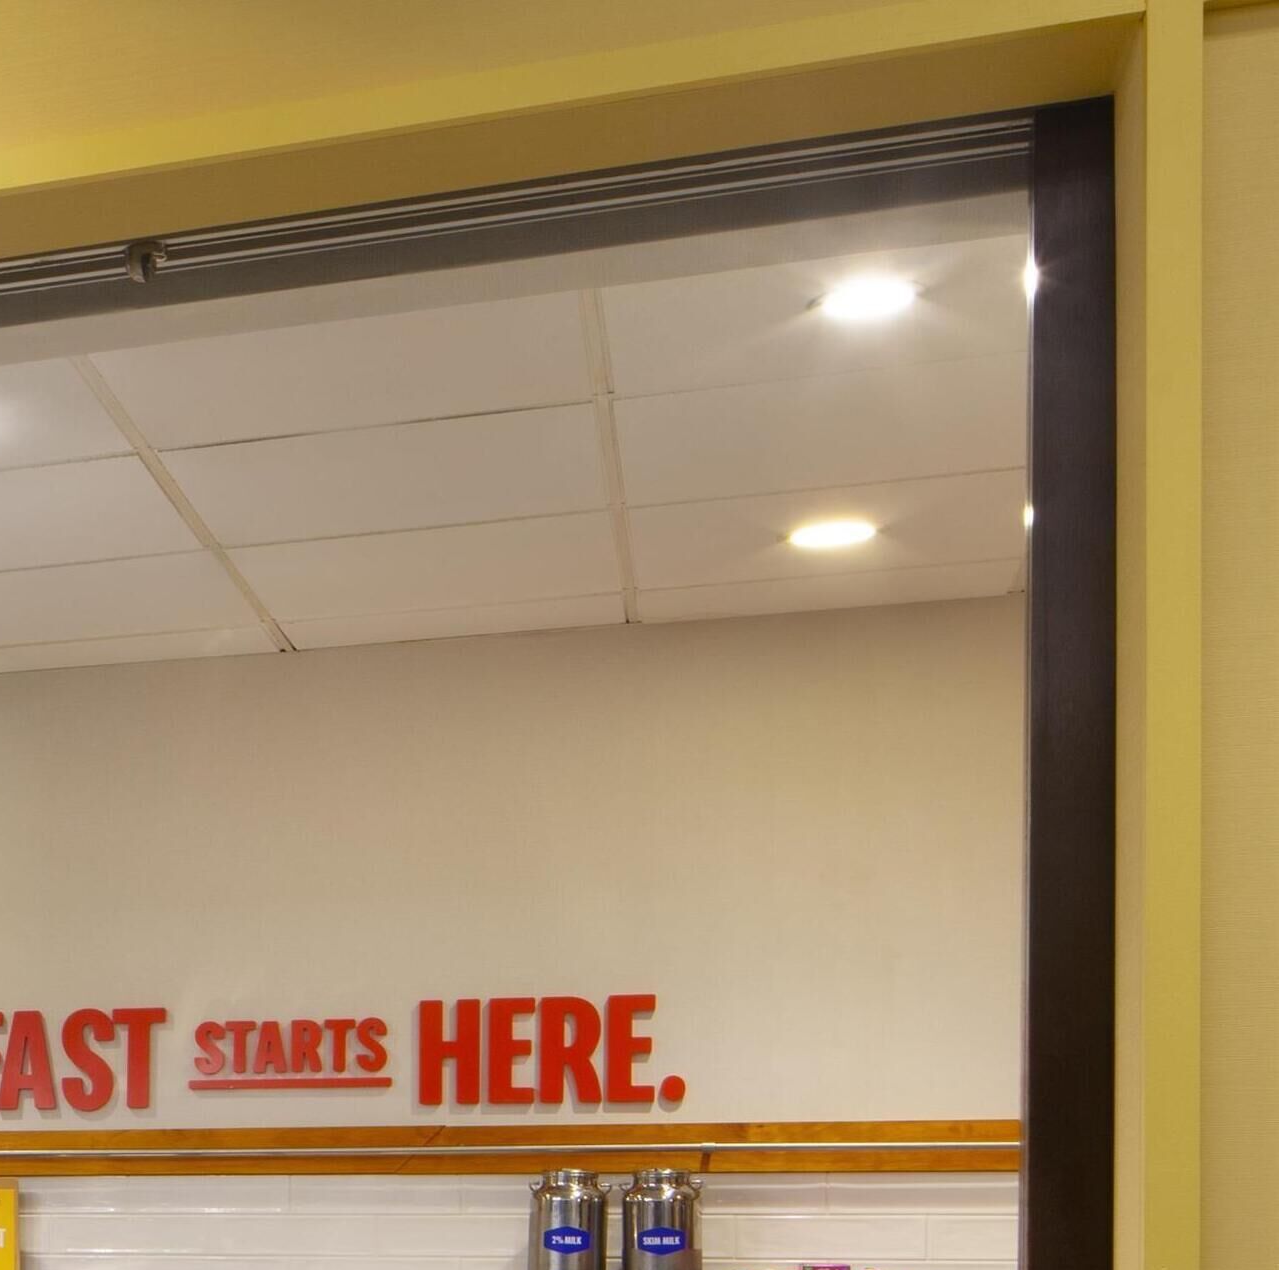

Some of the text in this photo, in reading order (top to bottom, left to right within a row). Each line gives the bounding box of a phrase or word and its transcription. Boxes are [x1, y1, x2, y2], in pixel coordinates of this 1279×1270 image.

[193, 1016, 388, 1075] STARTS
[418, 994, 686, 1107] HERE.
[564, 1235, 582, 1245] MILK
[642, 1236, 681, 1246] SKIM MILK
